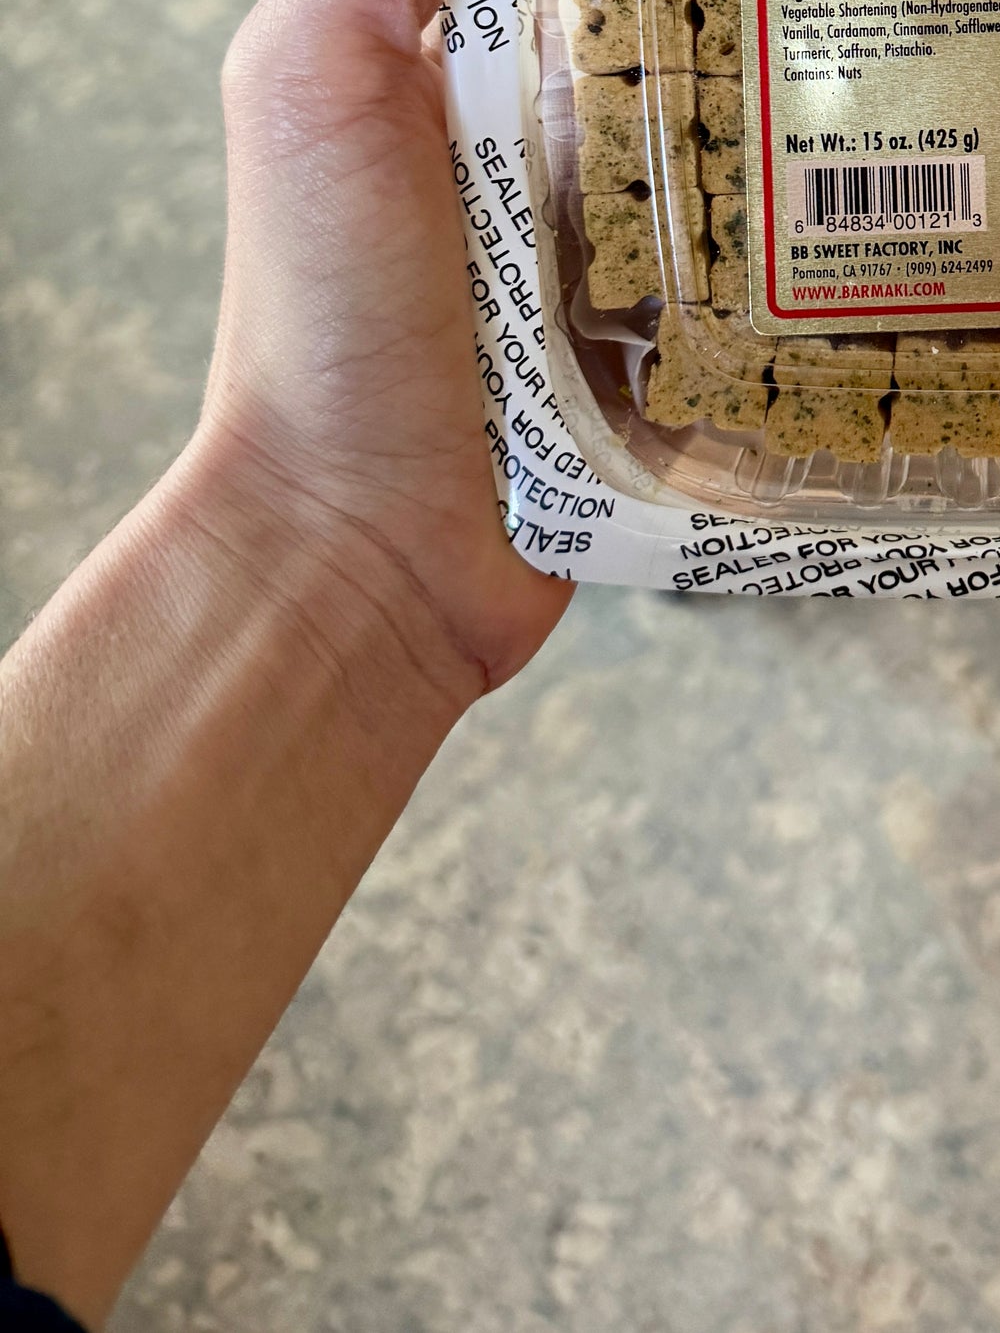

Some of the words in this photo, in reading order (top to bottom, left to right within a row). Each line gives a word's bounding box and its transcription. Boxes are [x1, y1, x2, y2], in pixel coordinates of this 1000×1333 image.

[781, 2, 835, 22] Vegetable
[839, 2, 897, 19] Shortening
[782, 24, 823, 42] Vanilla,
[827, 22, 890, 39] Cardamom,
[893, 22, 952, 37] Cinnamon,
[783, 46, 834, 61] Turmeric,
[837, 43, 881, 60] Saffron,
[885, 40, 936, 57] Pistachio.
[783, 67, 833, 82] Contains:
[838, 66, 862, 79] Nuts
[786, 134, 814, 153] Net
[820, 133, 856, 152] Wt.:
[863, 131, 883, 151] 15
[889, 136, 913, 150] oz.
[918, 129, 958, 152] (425
[963, 127, 979, 153] g)
[795, 220, 804, 234] 6
[826, 215, 885, 233] 84834
[893, 212, 950, 230] 00121
[972, 213, 982, 227] 3
[791, 245, 808, 260] BB
[814, 243, 860, 259] SWEET
[865, 241, 934, 257] FACTORY,
[938, 239, 963, 254] INC
[792, 267, 839, 280] Pomona,
[843, 264, 857, 277] CA
[860, 263, 892, 277] 91767
[906, 261, 936, 277] (909)
[941, 259, 993, 274] 624-2499
[792, 282, 946, 300] WWW.BARMAKI.COM
[497, 322, 544, 399] YOUR
[485, 419, 614, 519] PROTECTION
[672, 552, 791, 591] SEALED
[857, 558, 940, 594] YOUR
